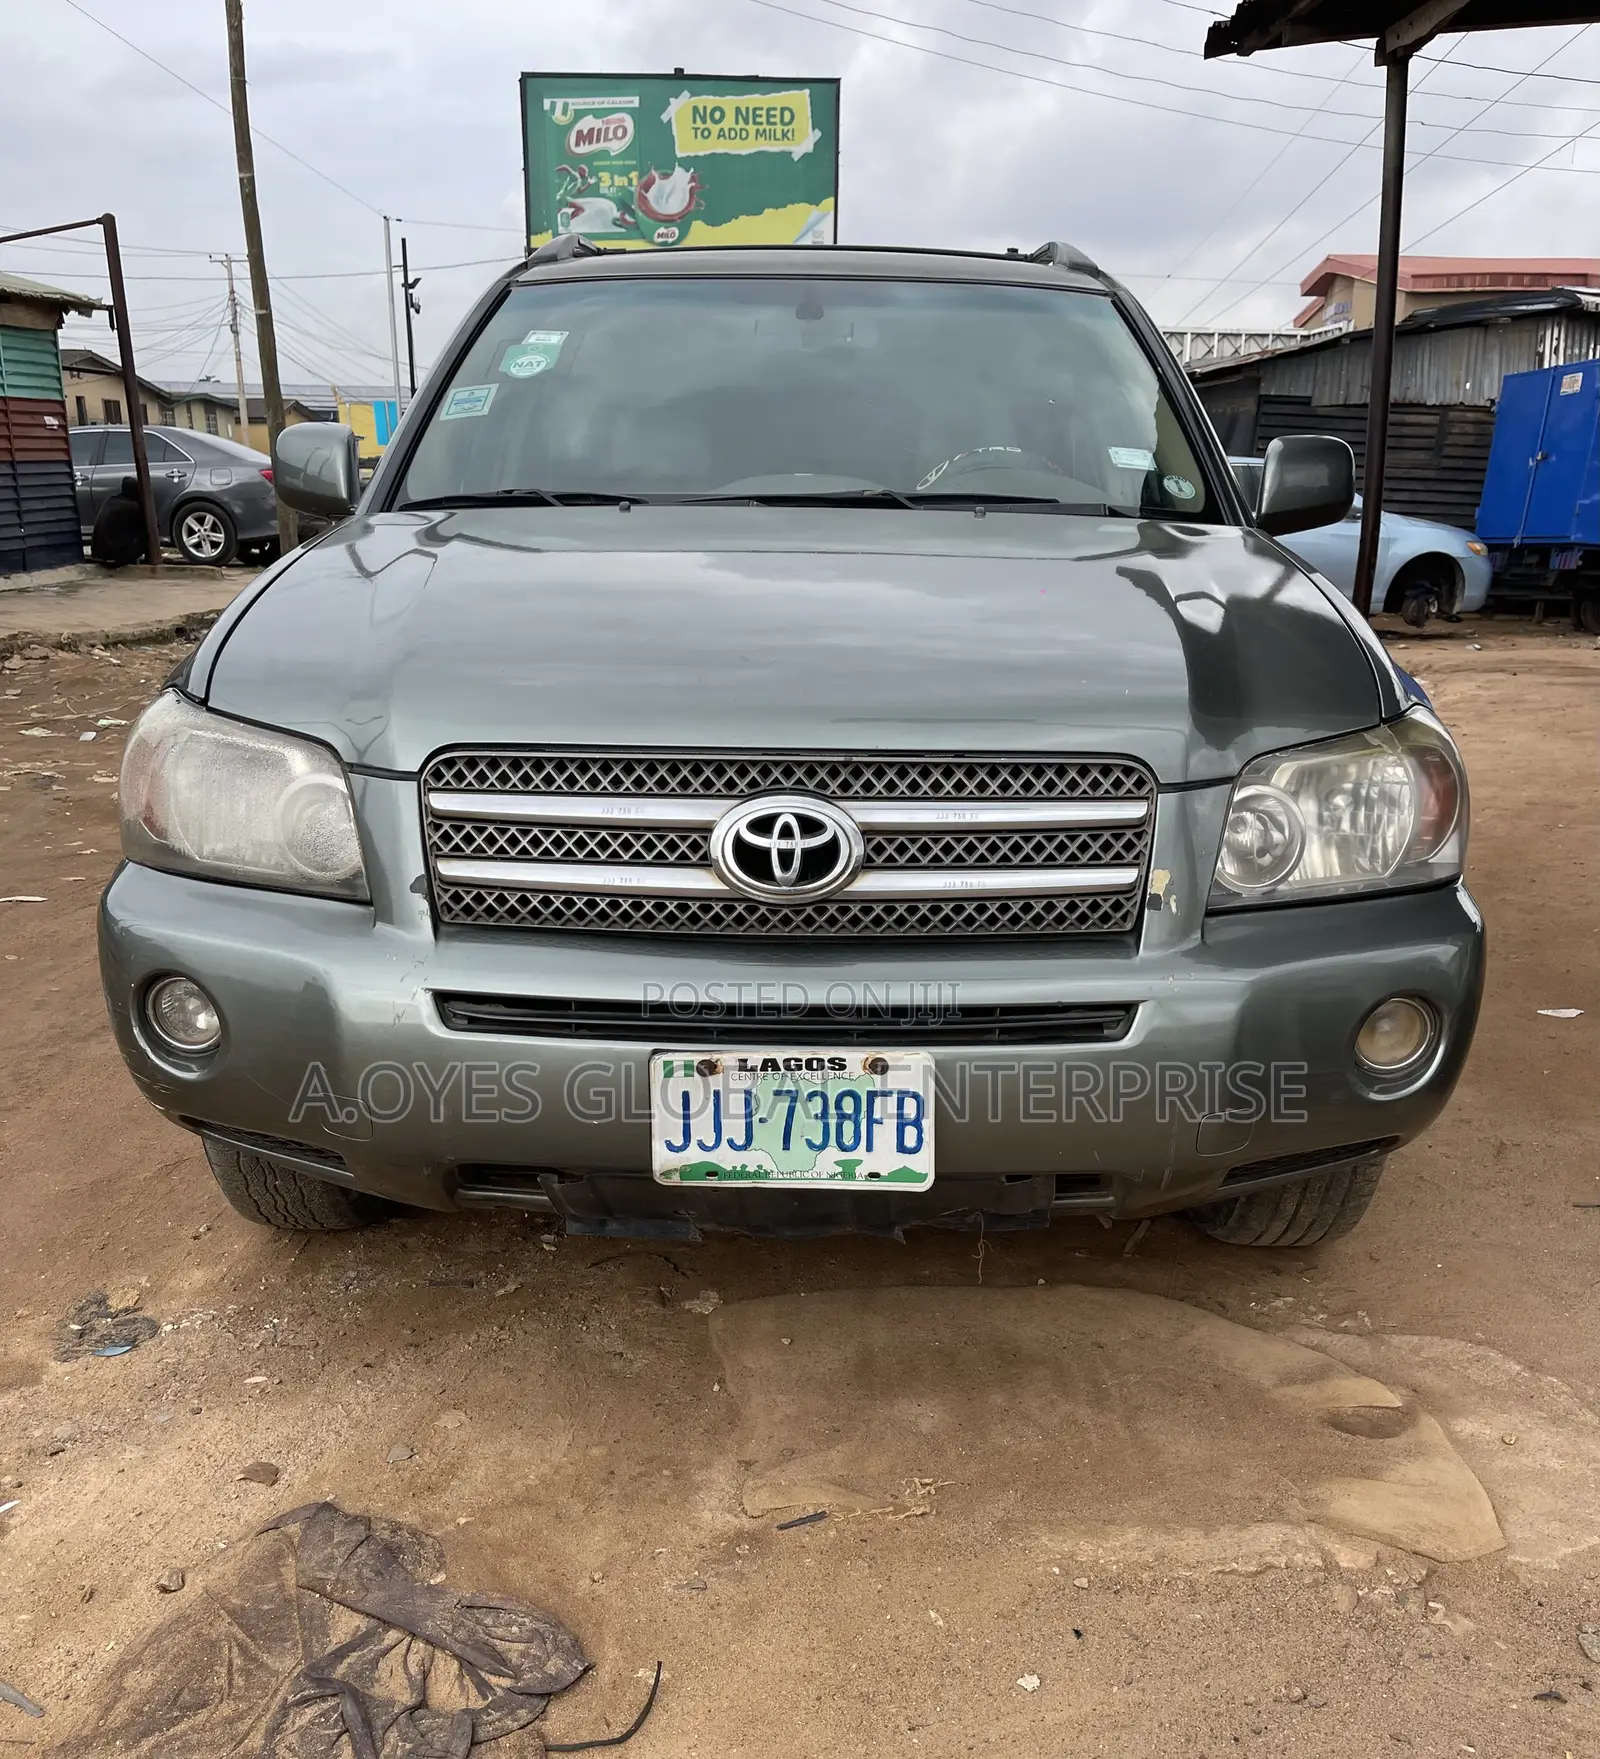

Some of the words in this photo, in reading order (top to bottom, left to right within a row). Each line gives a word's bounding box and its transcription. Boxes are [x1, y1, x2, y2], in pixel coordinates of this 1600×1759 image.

[692, 105, 725, 125] NO
[734, 106, 795, 126] NEED
[575, 125, 628, 148] MILO
[692, 127, 711, 140] TO
[717, 127, 749, 141] ADD
[755, 128, 795, 141] MILK!
[657, 231, 676, 240] MILO
[512, 360, 545, 369] NAT
[738, 1057, 847, 1072] LAGOS
[731, 1072, 768, 1081] CENTRE
[772, 1072, 785, 1081] OF
[790, 1071, 854, 1081] EXCELLENCE
[664, 1088, 925, 1155] JJJ-738FB
[723, 1171, 761, 1180] FEDERAL
[765, 1170, 809, 1180] REPUBLIC
[810, 1170, 824, 1179] OF
[826, 1171, 864, 1180] NIGERIA
